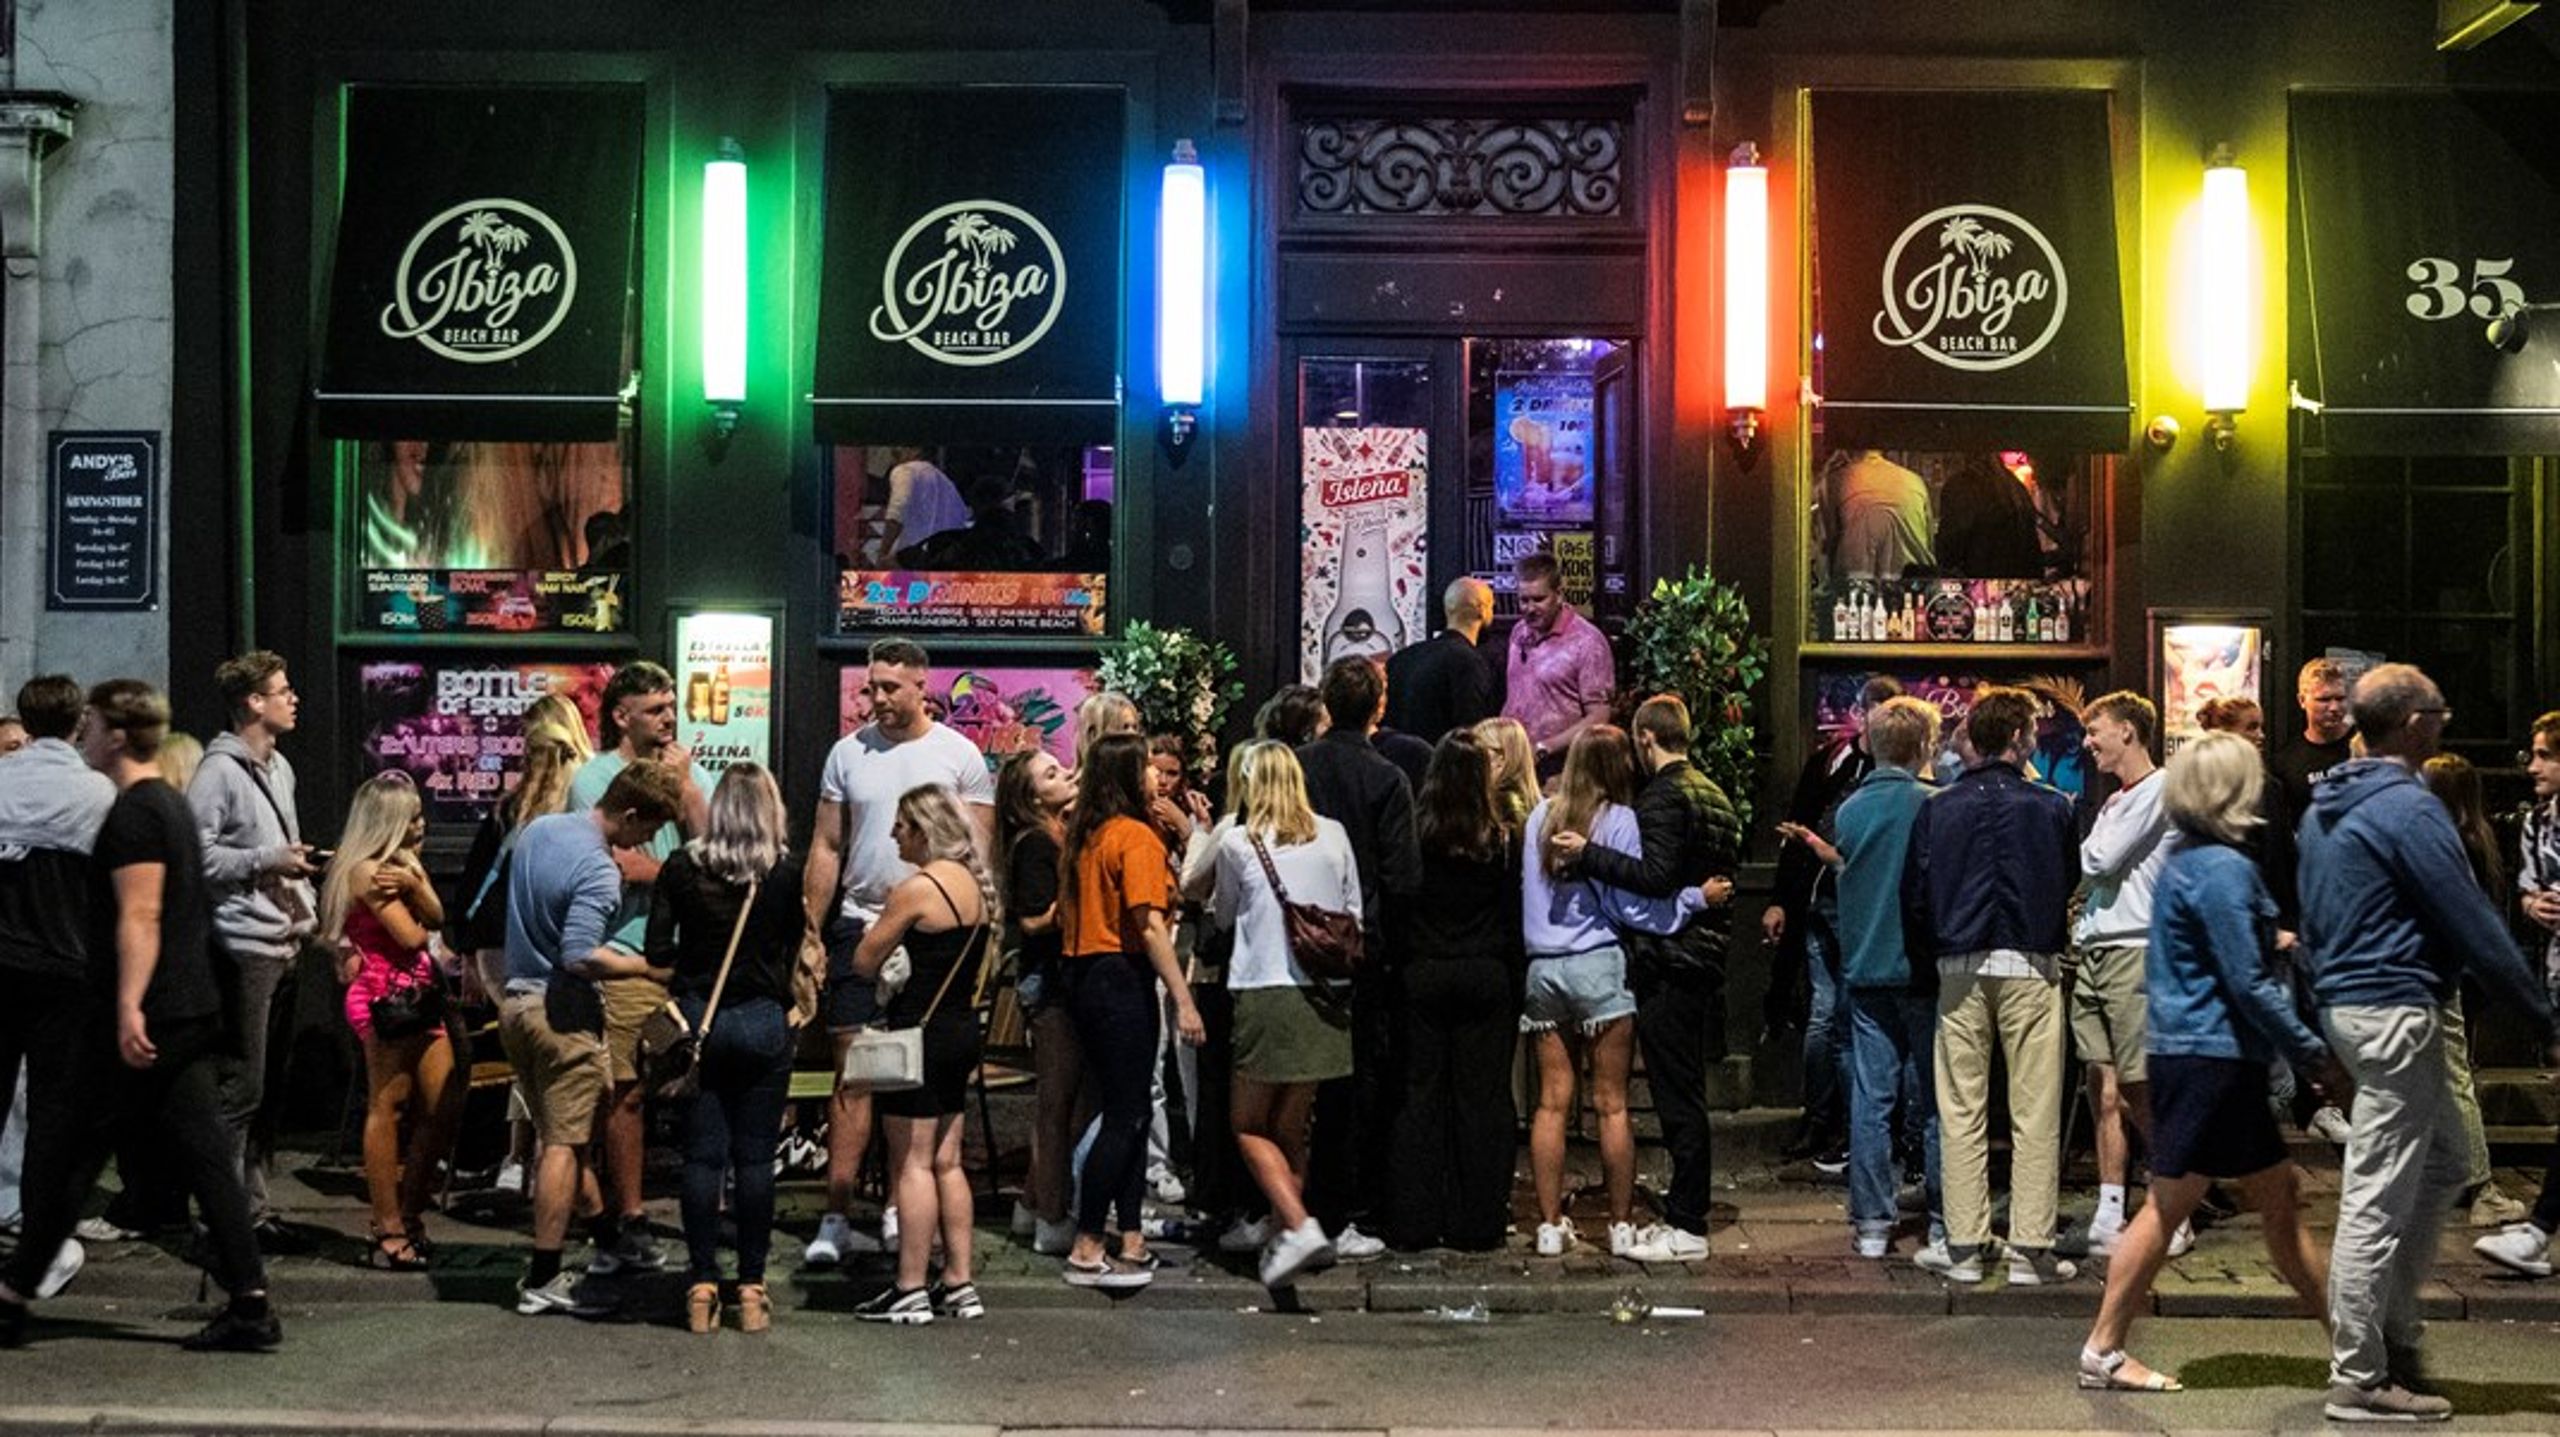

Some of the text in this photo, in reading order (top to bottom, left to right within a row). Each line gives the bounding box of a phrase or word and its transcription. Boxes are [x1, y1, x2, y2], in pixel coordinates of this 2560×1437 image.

[381, 247, 559, 338] Ibiza
[869, 248, 1048, 341] Ibiza
[2406, 257, 2525, 320] 35
[1873, 253, 2049, 346] Ibiza
[443, 329, 520, 343] BEACH BAR
[934, 331, 1010, 345] BEACH BAR
[1939, 336, 2018, 350] BEACH BAR
[70, 453, 135, 470] ANDY'S
[906, 580, 1021, 605] DRINKS
[971, 607, 999, 617] BLUE
[976, 618, 996, 628] SEX
[997, 618, 1016, 628] ON
[1018, 619, 1038, 629] THE
[1040, 619, 1076, 630] BEACH
[437, 670, 547, 697] BOTTLE
[437, 697, 467, 715] OF
